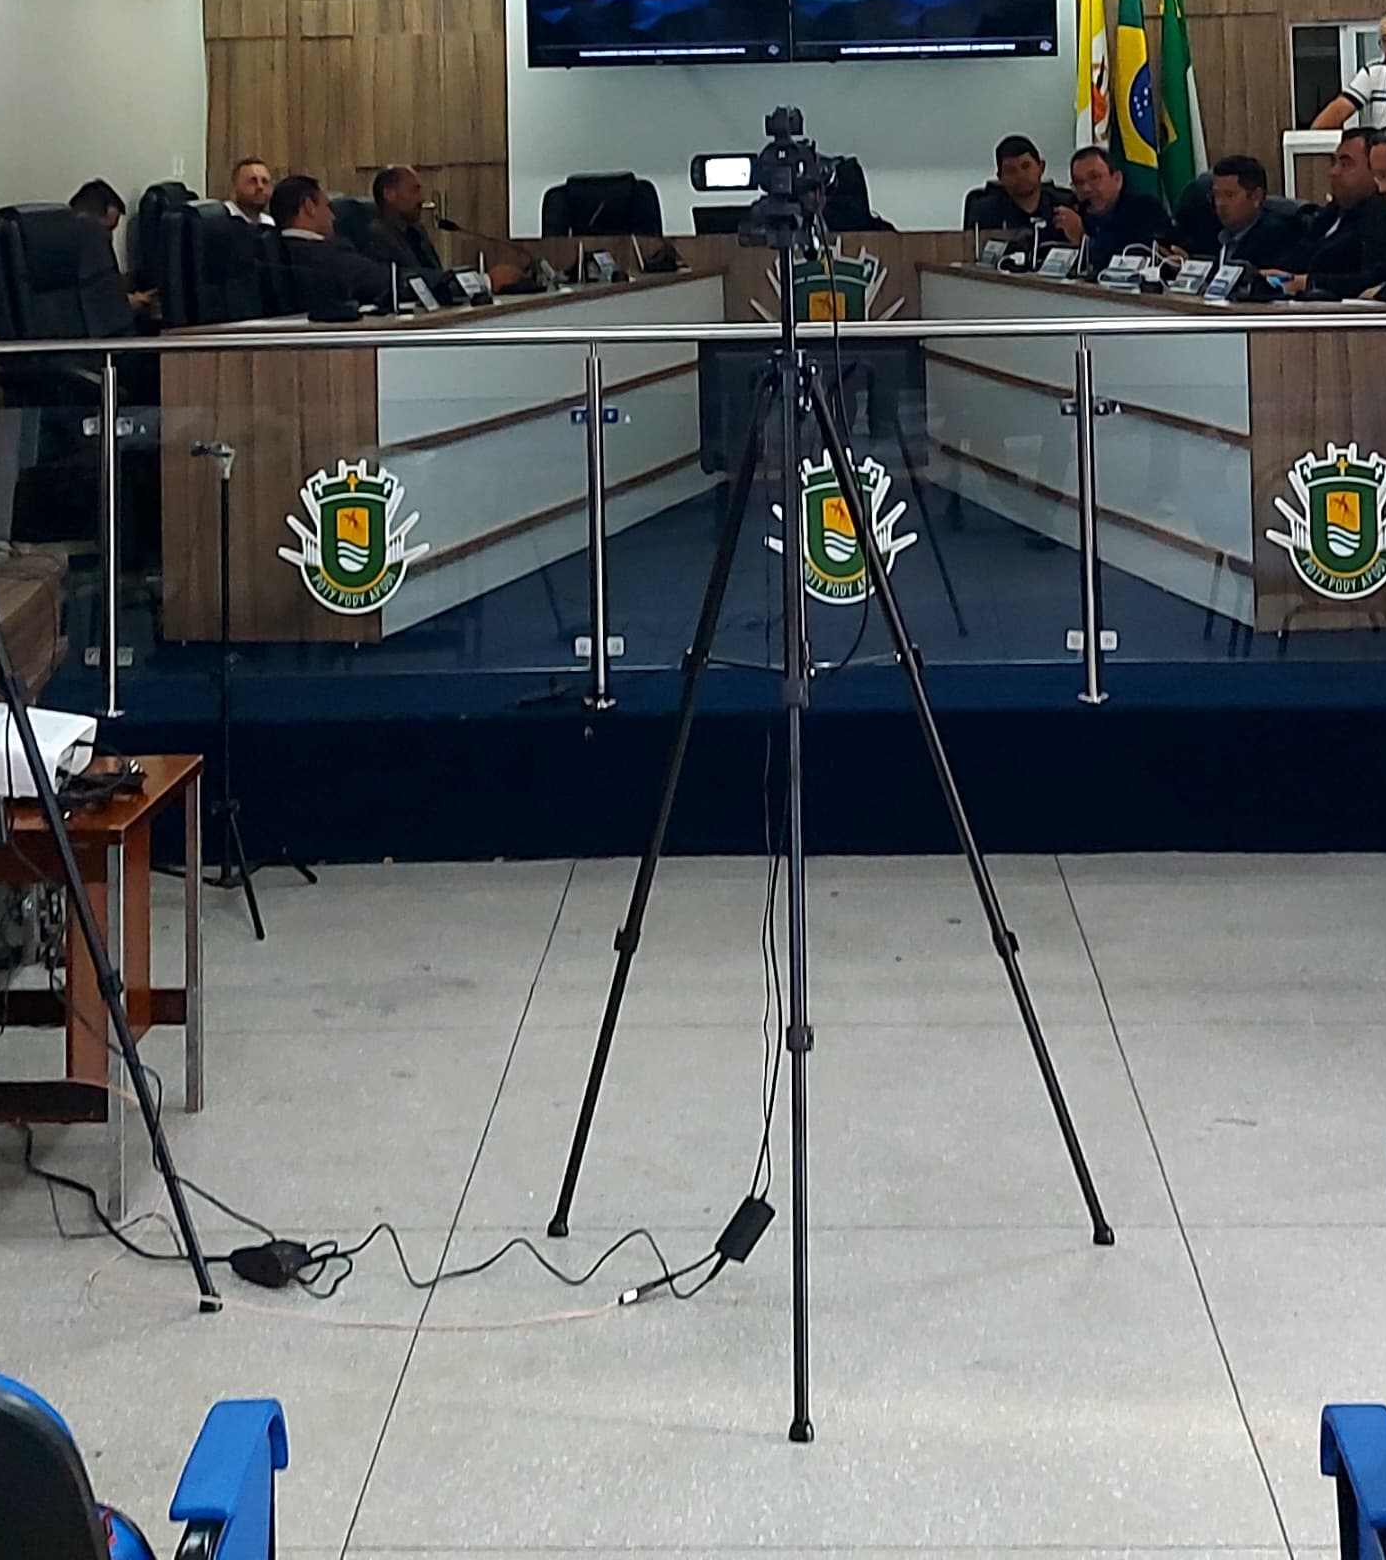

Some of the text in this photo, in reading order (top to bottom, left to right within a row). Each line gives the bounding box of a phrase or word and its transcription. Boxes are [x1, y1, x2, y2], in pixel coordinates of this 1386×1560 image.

[1301, 557, 1328, 585] POTY
[1328, 578, 1356, 593] PODY
[825, 582, 853, 597] PODY
